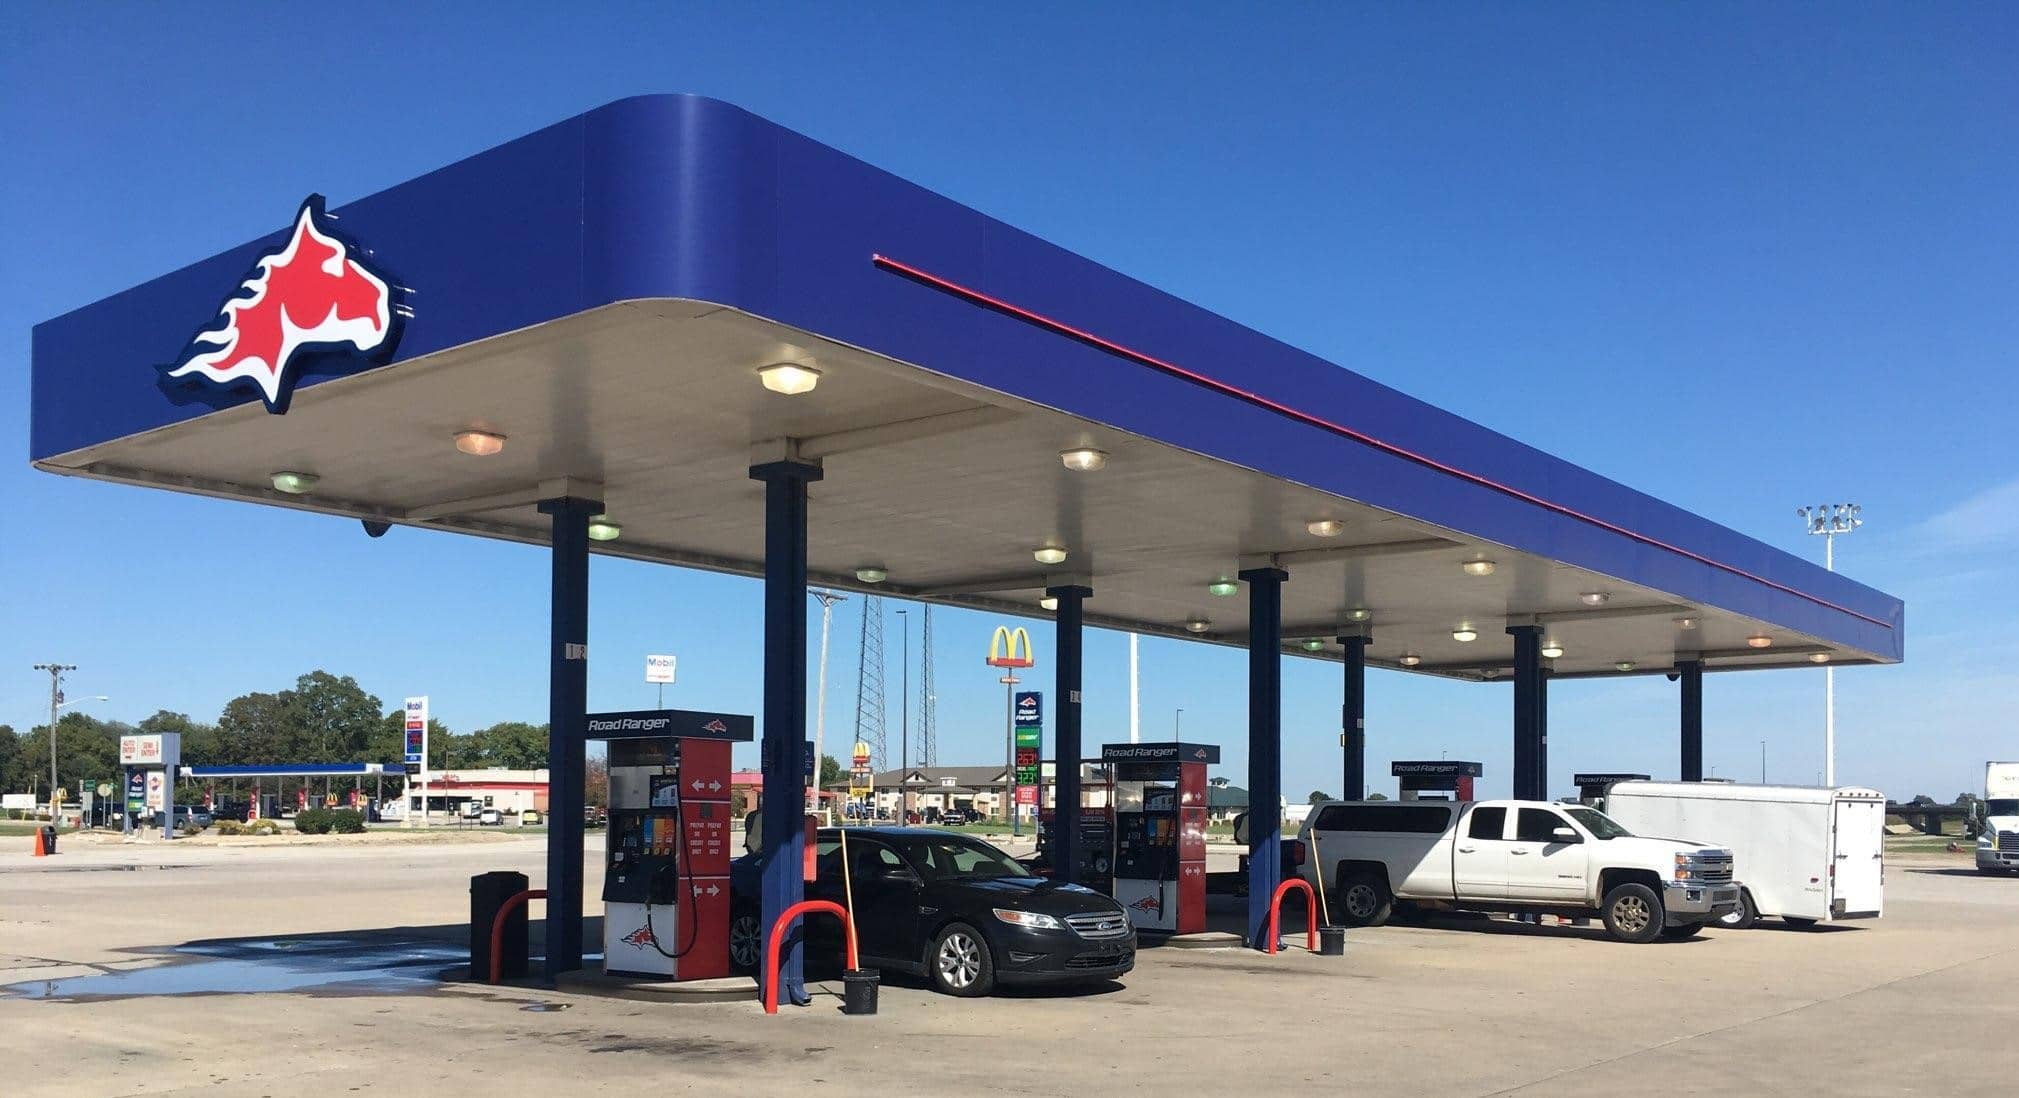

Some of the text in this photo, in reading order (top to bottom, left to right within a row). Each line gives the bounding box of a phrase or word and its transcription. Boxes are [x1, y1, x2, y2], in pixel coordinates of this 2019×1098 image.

[648, 658, 674, 666] Mobil
[407, 701, 422, 710] Mobil
[589, 719, 670, 731] Road Ranger
[1104, 748, 1177, 757] Road Ranger
